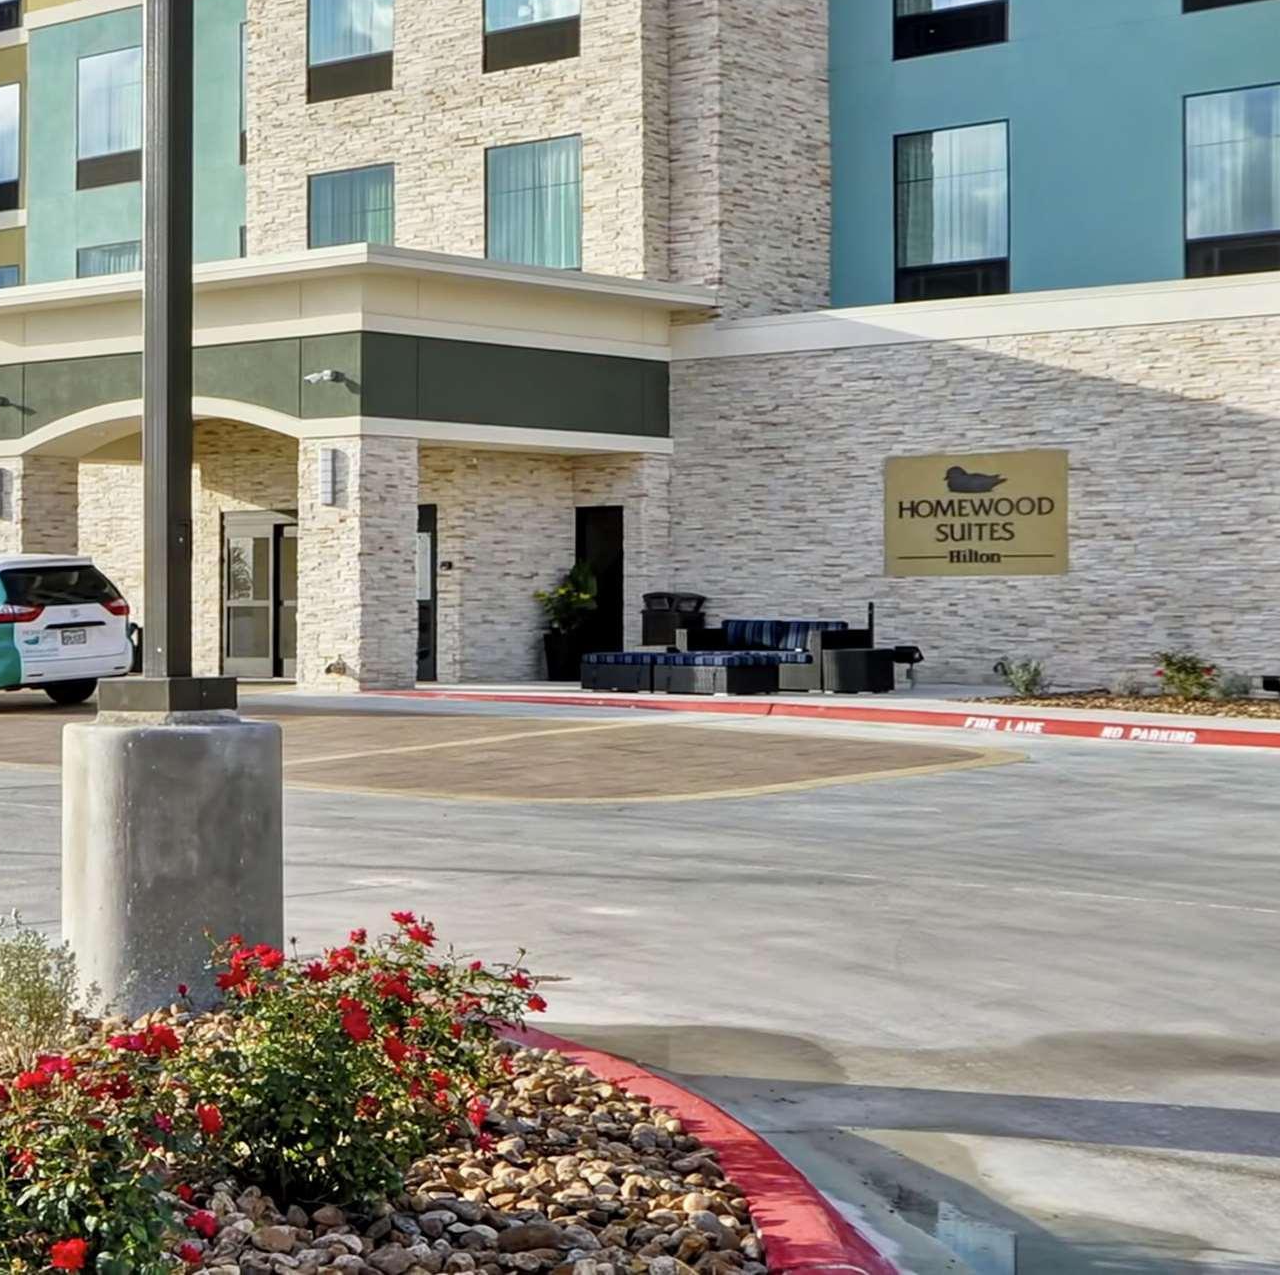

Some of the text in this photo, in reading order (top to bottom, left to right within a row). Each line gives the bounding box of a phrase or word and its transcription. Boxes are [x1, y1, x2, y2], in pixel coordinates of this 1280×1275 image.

[897, 496, 1055, 519] HOMEWOOD
[935, 522, 1016, 543] SUITES
[948, 548, 1002, 564] Hilton
[964, 716, 1197, 743] FIRE LANE NO PARKING
